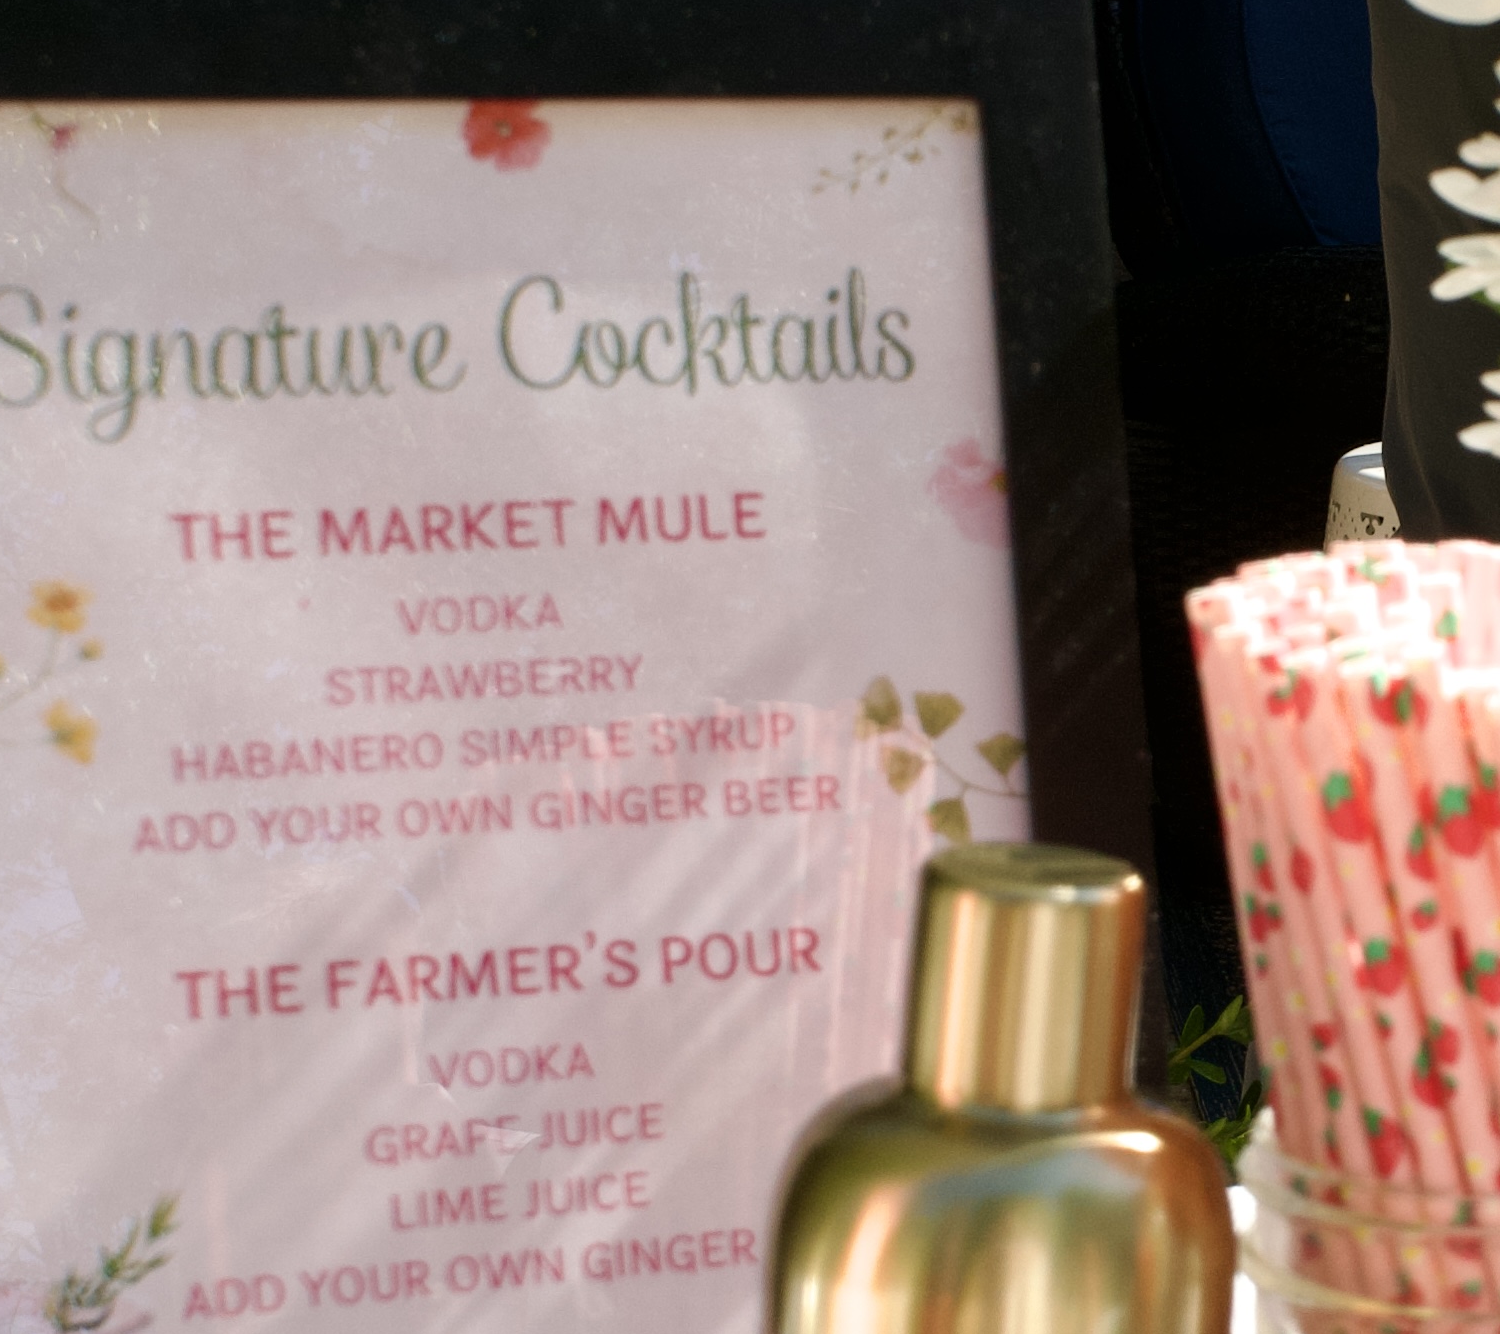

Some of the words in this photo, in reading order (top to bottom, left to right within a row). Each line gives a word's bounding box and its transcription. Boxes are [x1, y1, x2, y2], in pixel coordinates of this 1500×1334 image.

[498, 267, 916, 395] Cocktails
[167, 510, 297, 564] THE
[316, 498, 578, 557] MARKET
[596, 491, 768, 545] MULE
[396, 593, 562, 635] VODKA
[324, 654, 642, 707] STRAWBERRY
[171, 732, 443, 783] HABANERO
[459, 721, 636, 765] SIMPLE
[648, 711, 796, 752] SYRUP
[134, 813, 238, 853] ADD
[250, 803, 382, 849] YOUR
[398, 797, 514, 839] OWN
[530, 783, 710, 831] GINGER
[723, 775, 842, 817] BEER
[174, 963, 304, 1022] THE
[326, 931, 640, 1009] FARMER'S
[660, 925, 824, 983] POUR
[428, 1043, 596, 1091] VODKA
[536, 1101, 666, 1151] JUICE
[390, 1185, 510, 1231] LIME
[524, 1171, 652, 1219] JUICE
[182, 1273, 288, 1322] ADD
[300, 1259, 432, 1309] YOUR
[446, 1247, 566, 1293] OWN
[580, 1227, 760, 1283] GINGER
